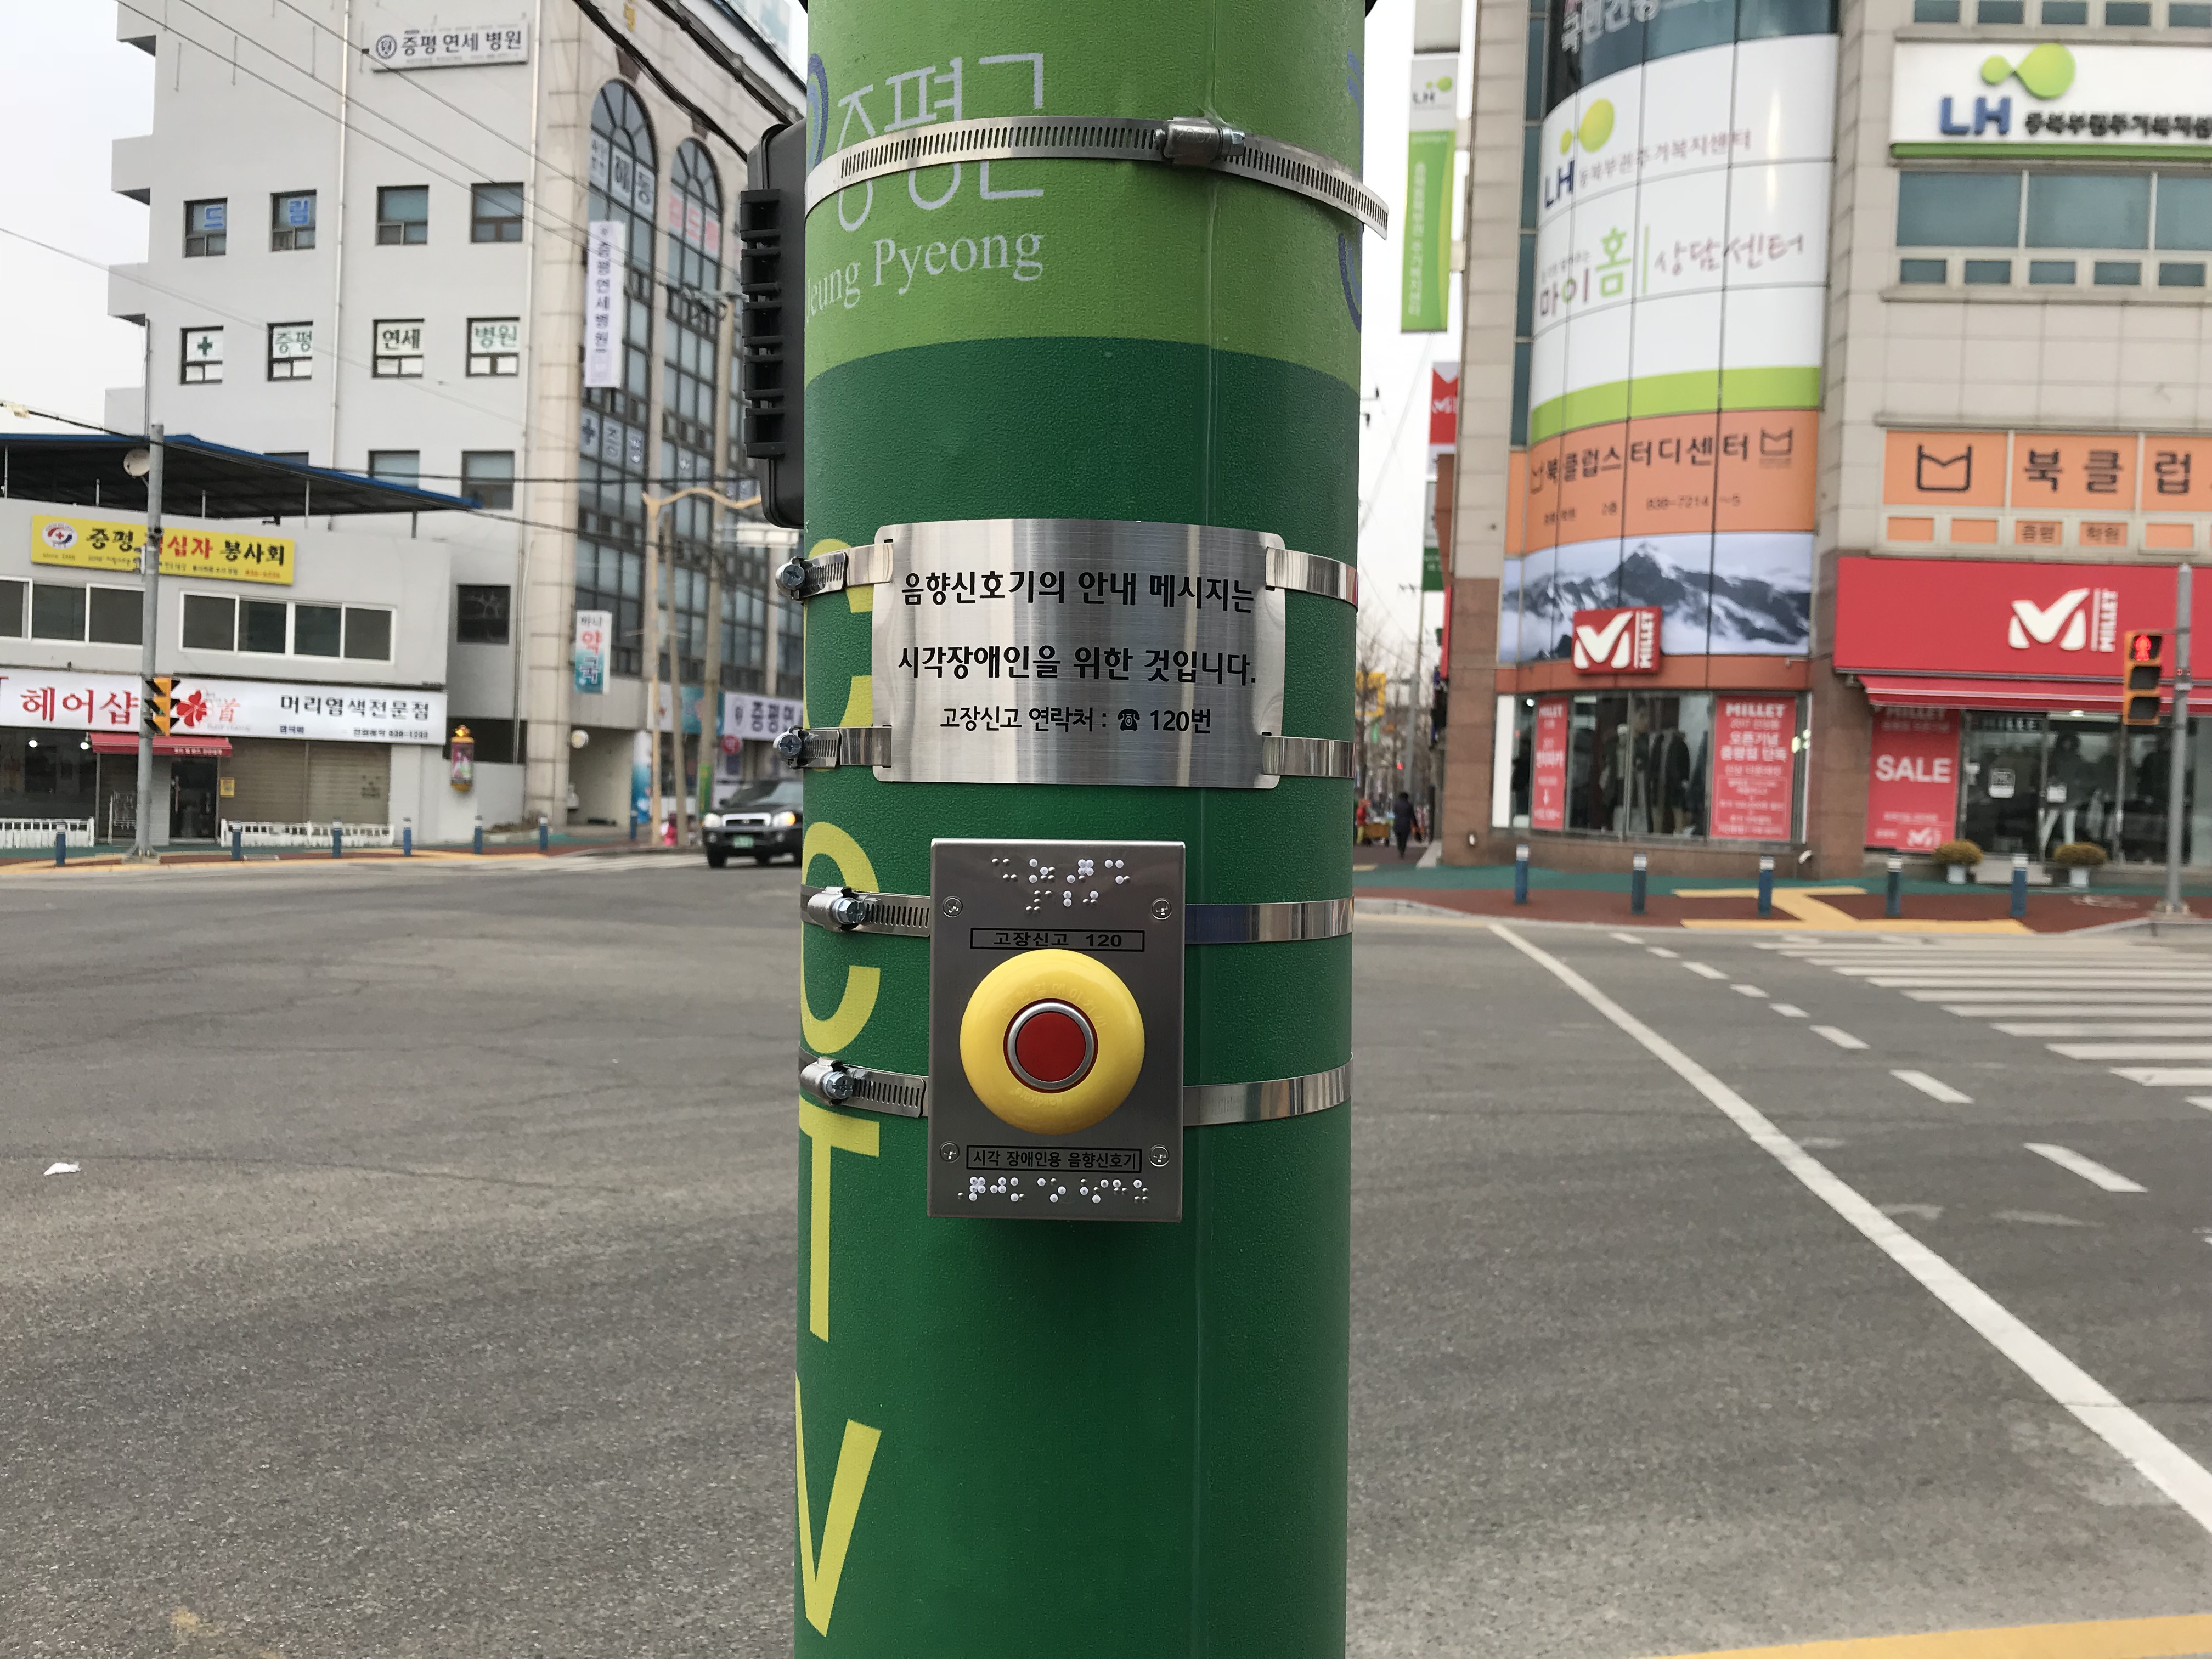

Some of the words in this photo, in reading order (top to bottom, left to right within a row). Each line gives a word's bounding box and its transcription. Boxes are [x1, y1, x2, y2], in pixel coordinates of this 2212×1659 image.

[402, 36, 437, 55] 증평
[443, 33, 479, 53] 연세
[486, 30, 522, 50] 병원
[1940, 95, 2012, 136] LH
[1544, 159, 1575, 210] LH
[873, 233, 1045, 295] Pyeong
[1654, 233, 1804, 276] 상담센터
[275, 330, 312, 354] 증평
[382, 328, 421, 350] 연세
[475, 325, 518, 348] 병원
[1545, 433, 1751, 484] 북클럽스터디센터
[86, 527, 134, 552] 증평
[144, 532, 213, 560] 십자
[219, 539, 285, 566] 봉사회
[901, 571, 1065, 606] 음향신호기의
[1077, 571, 1137, 606] 안내
[1149, 574, 1255, 613] 메시지는
[898, 645, 1062, 680] 시각장애인을
[1073, 647, 1134, 681] 위한
[1144, 648, 1257, 686] 것입니다.
[20, 686, 140, 726] 헤어샵
[280, 694, 430, 721] 머리염색전문점
[940, 706, 1023, 732] 고장신고
[1028, 707, 1094, 733] 연락처
[1149, 709, 1212, 735] 120번
[1726, 702, 1787, 718] MILLET
[1875, 754, 1952, 783] SALE
[994, 932, 1069, 947] 고장신고
[1085, 934, 1122, 947] 120
[973, 1150, 1001, 1167] 시각
[1006, 1150, 1062, 1168] 장애인용
[1068, 1152, 1137, 1170] 음향신호기
